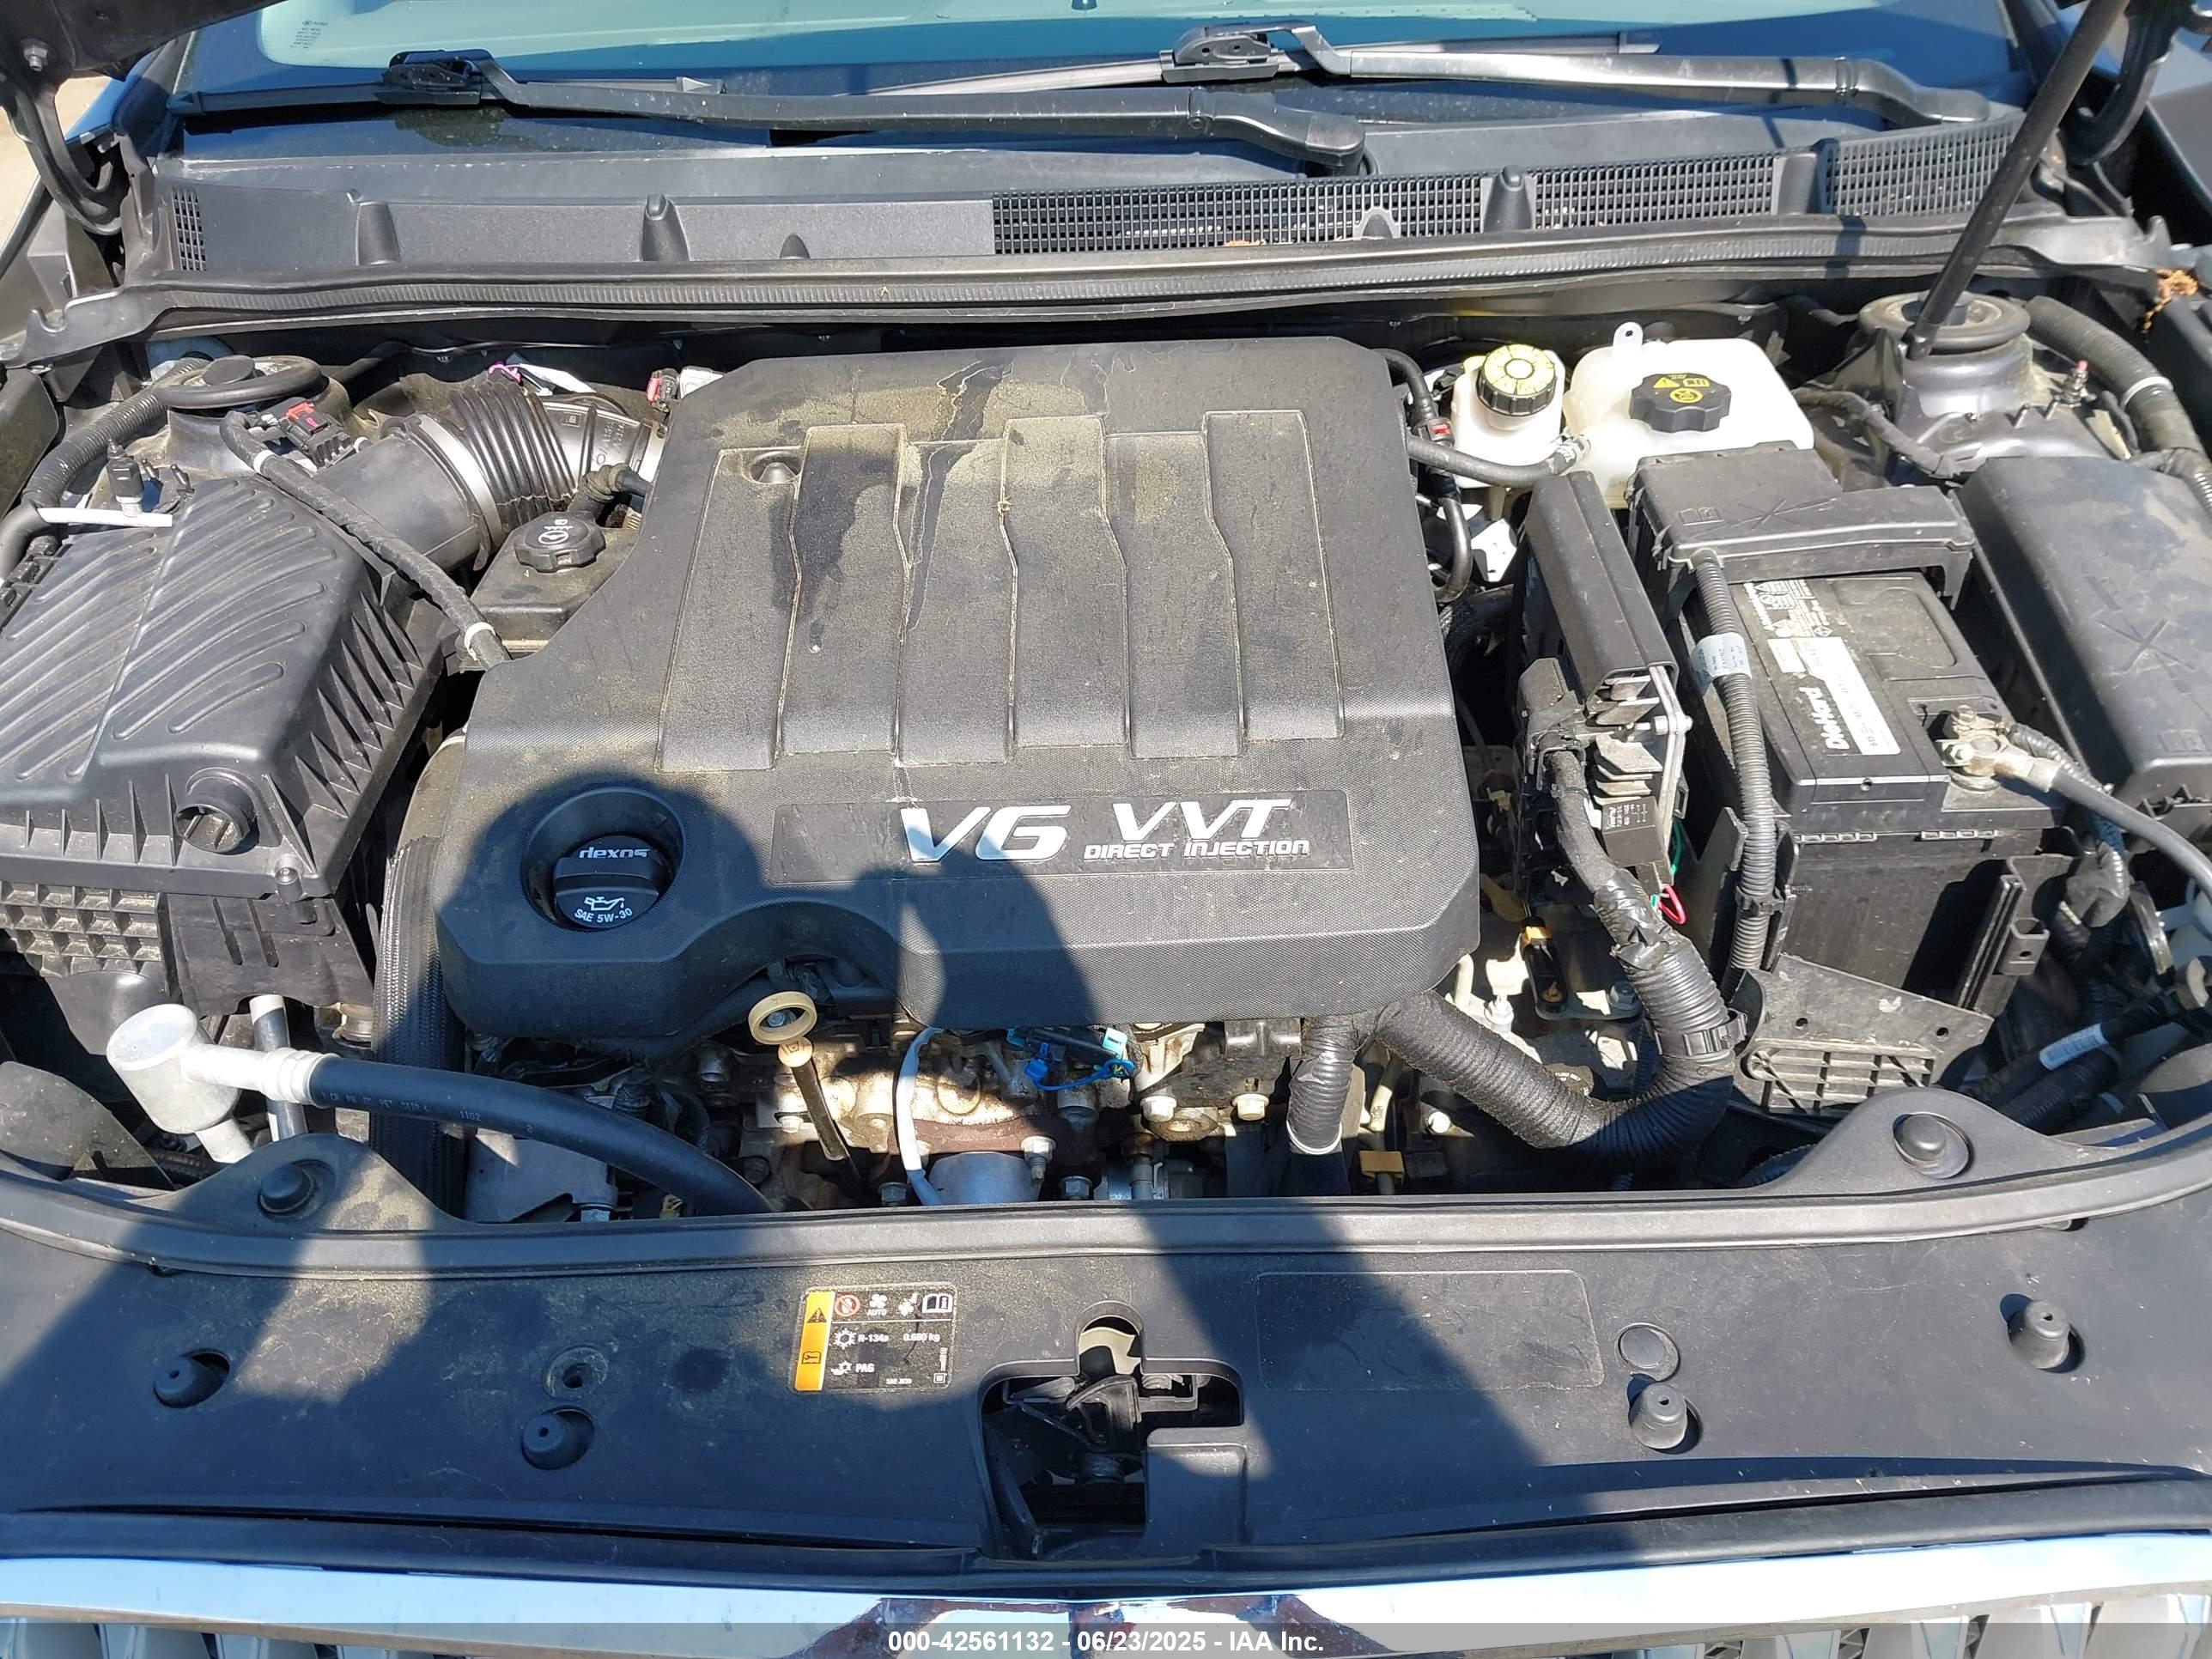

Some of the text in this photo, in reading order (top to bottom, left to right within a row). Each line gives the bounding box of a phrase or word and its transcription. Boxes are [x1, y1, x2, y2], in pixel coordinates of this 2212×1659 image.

[1798, 686, 1850, 750] DieHard
[1113, 799, 1292, 842] VVT
[900, 805, 1072, 862] V6
[578, 847, 651, 859] dexos
[1084, 839, 1310, 860] DIRECT INJECTION
[574, 908, 633, 923] SAE 5W-30
[857, 1334, 889, 1343] R-134a
[928, 1333, 941, 1343] kg
[855, 1364, 875, 1373] PAG
